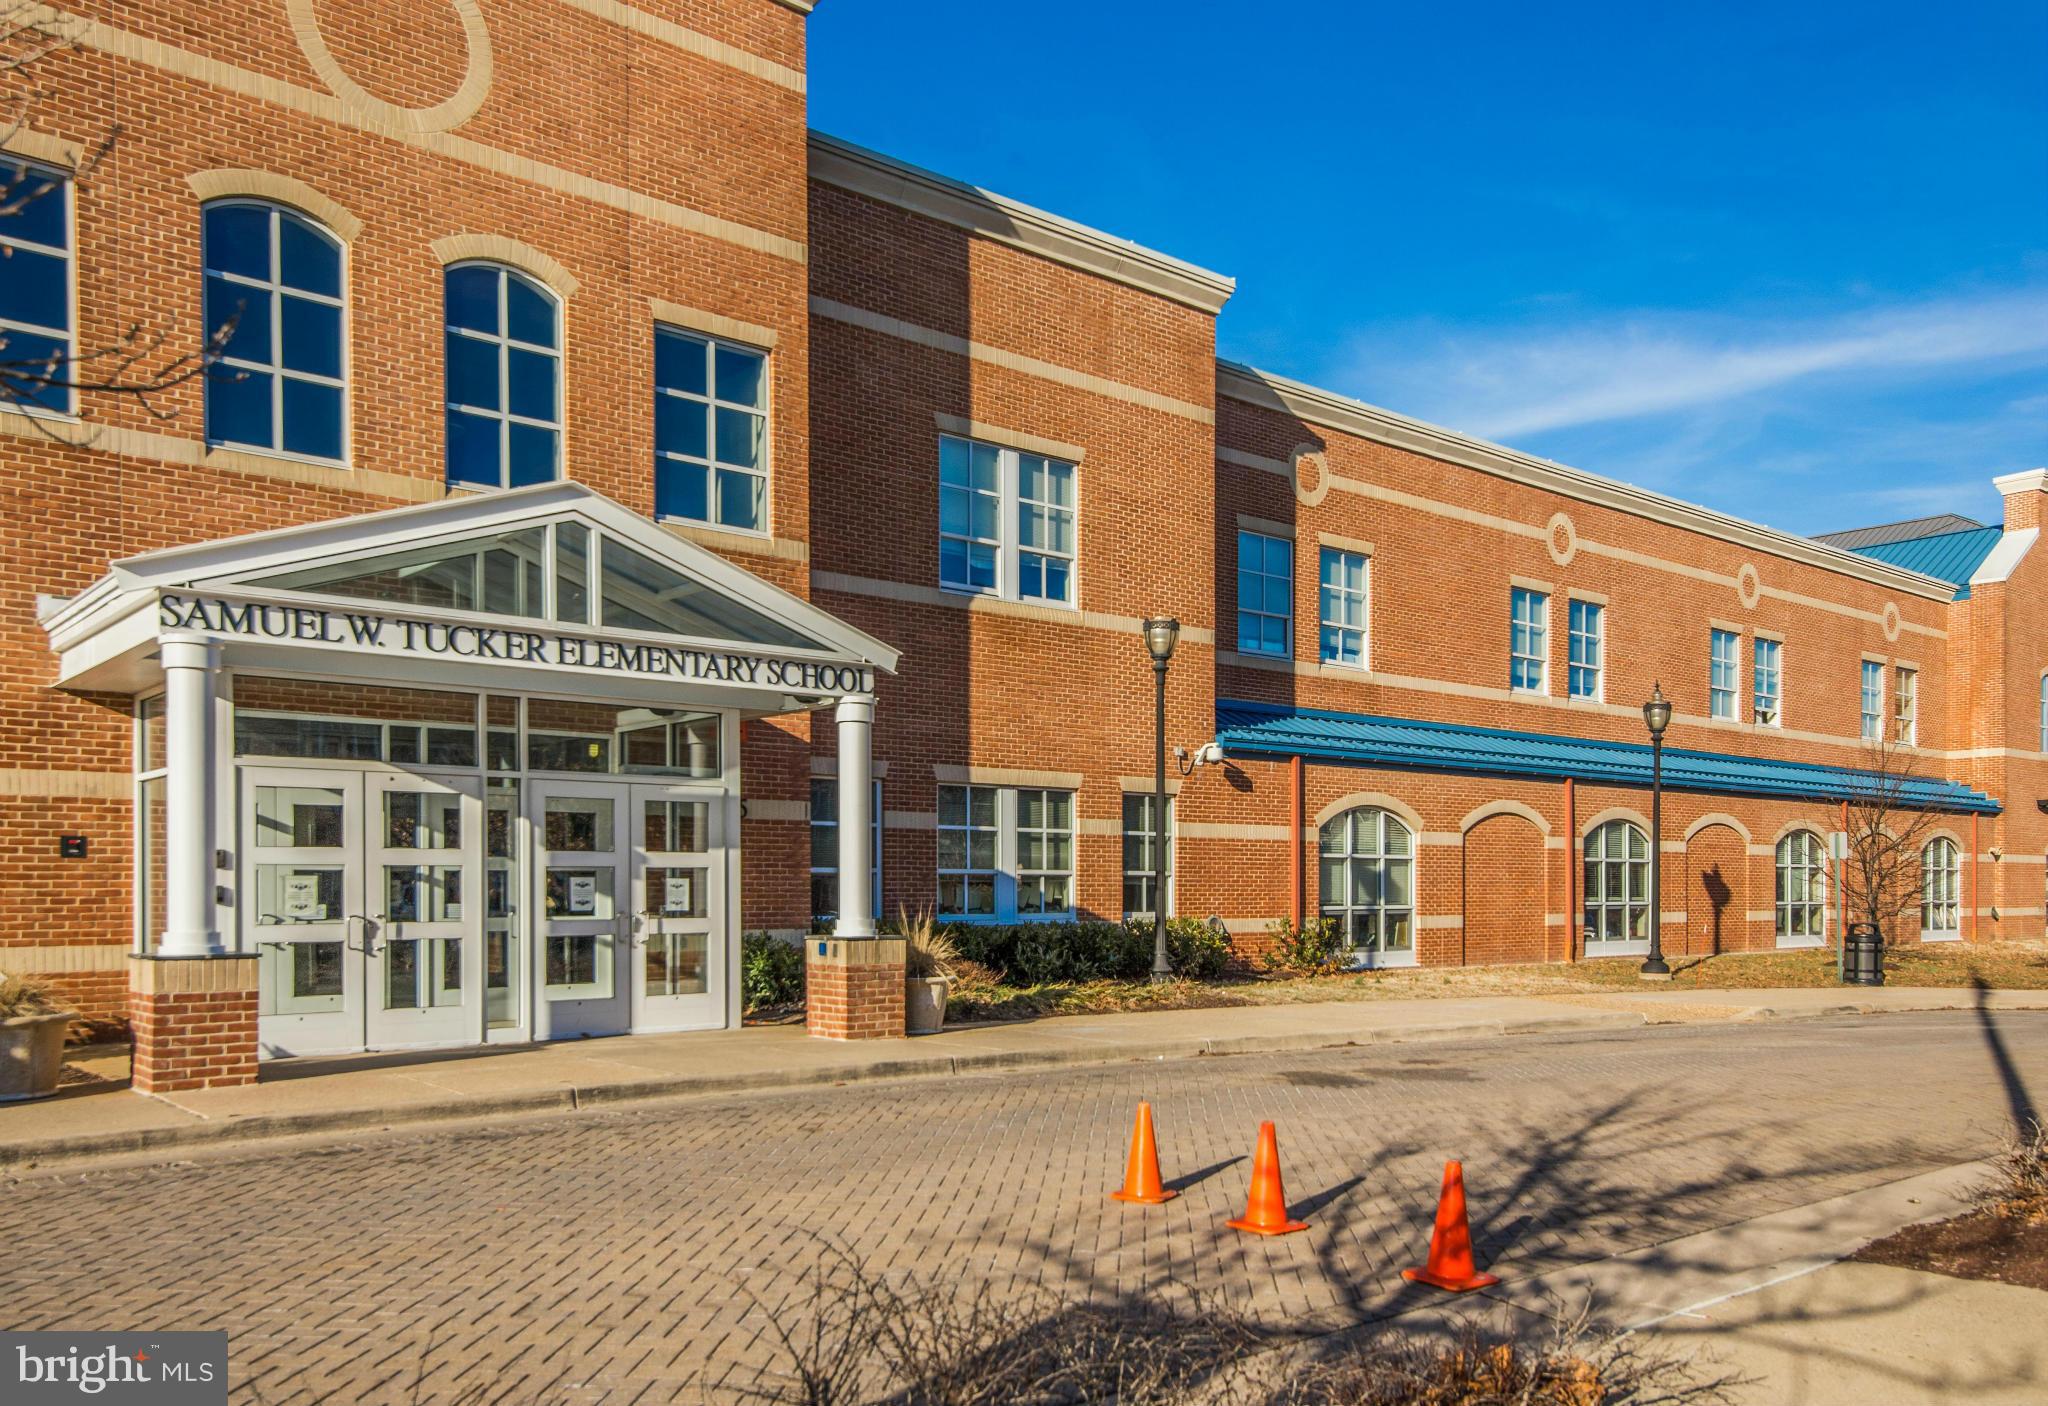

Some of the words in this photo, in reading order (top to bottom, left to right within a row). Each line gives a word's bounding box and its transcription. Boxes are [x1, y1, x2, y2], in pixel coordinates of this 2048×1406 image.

[160, 594, 345, 644] SAMUEL
[344, 612, 387, 648] W.
[396, 619, 549, 664] TUCKER
[555, 637, 763, 683] ELEMENTARY
[766, 659, 874, 695] SCHOOL
